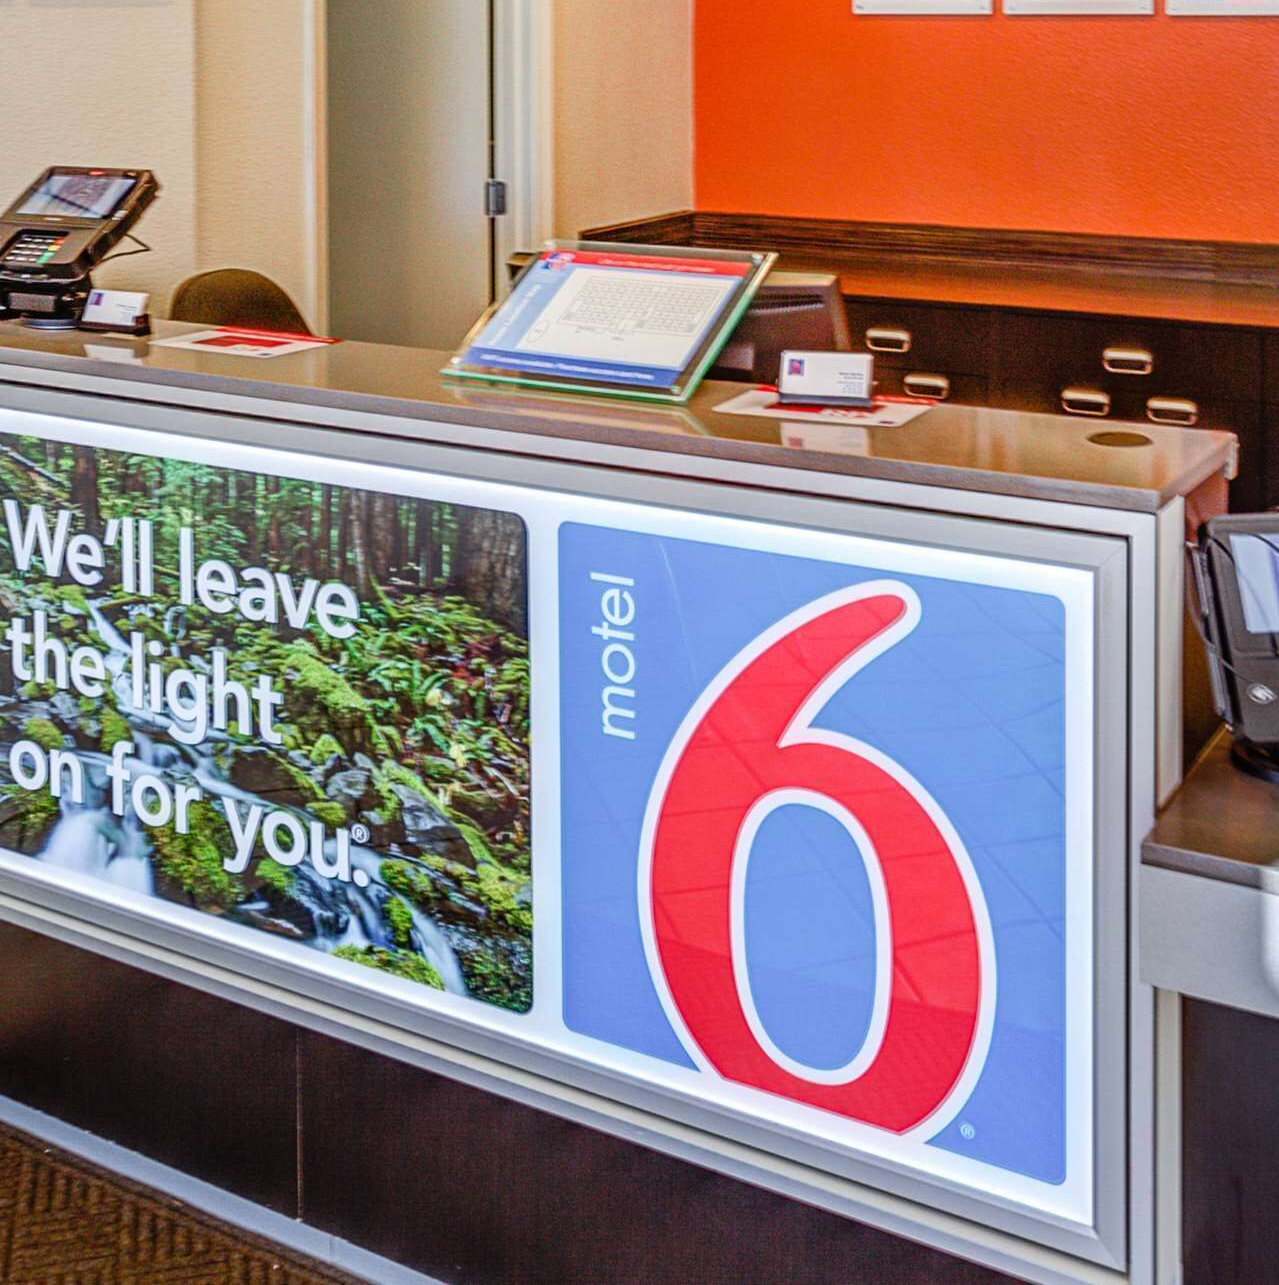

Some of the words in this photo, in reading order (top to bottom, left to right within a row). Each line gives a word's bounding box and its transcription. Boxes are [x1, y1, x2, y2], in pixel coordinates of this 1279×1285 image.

[2, 499, 153, 597] We'll
[179, 526, 360, 639] leave
[6, 611, 106, 698] the
[131, 631, 284, 745] light
[589, 573, 636, 741] motel
[9, 740, 85, 804] on
[106, 740, 204, 835] for
[640, 579, 997, 1138] 6
